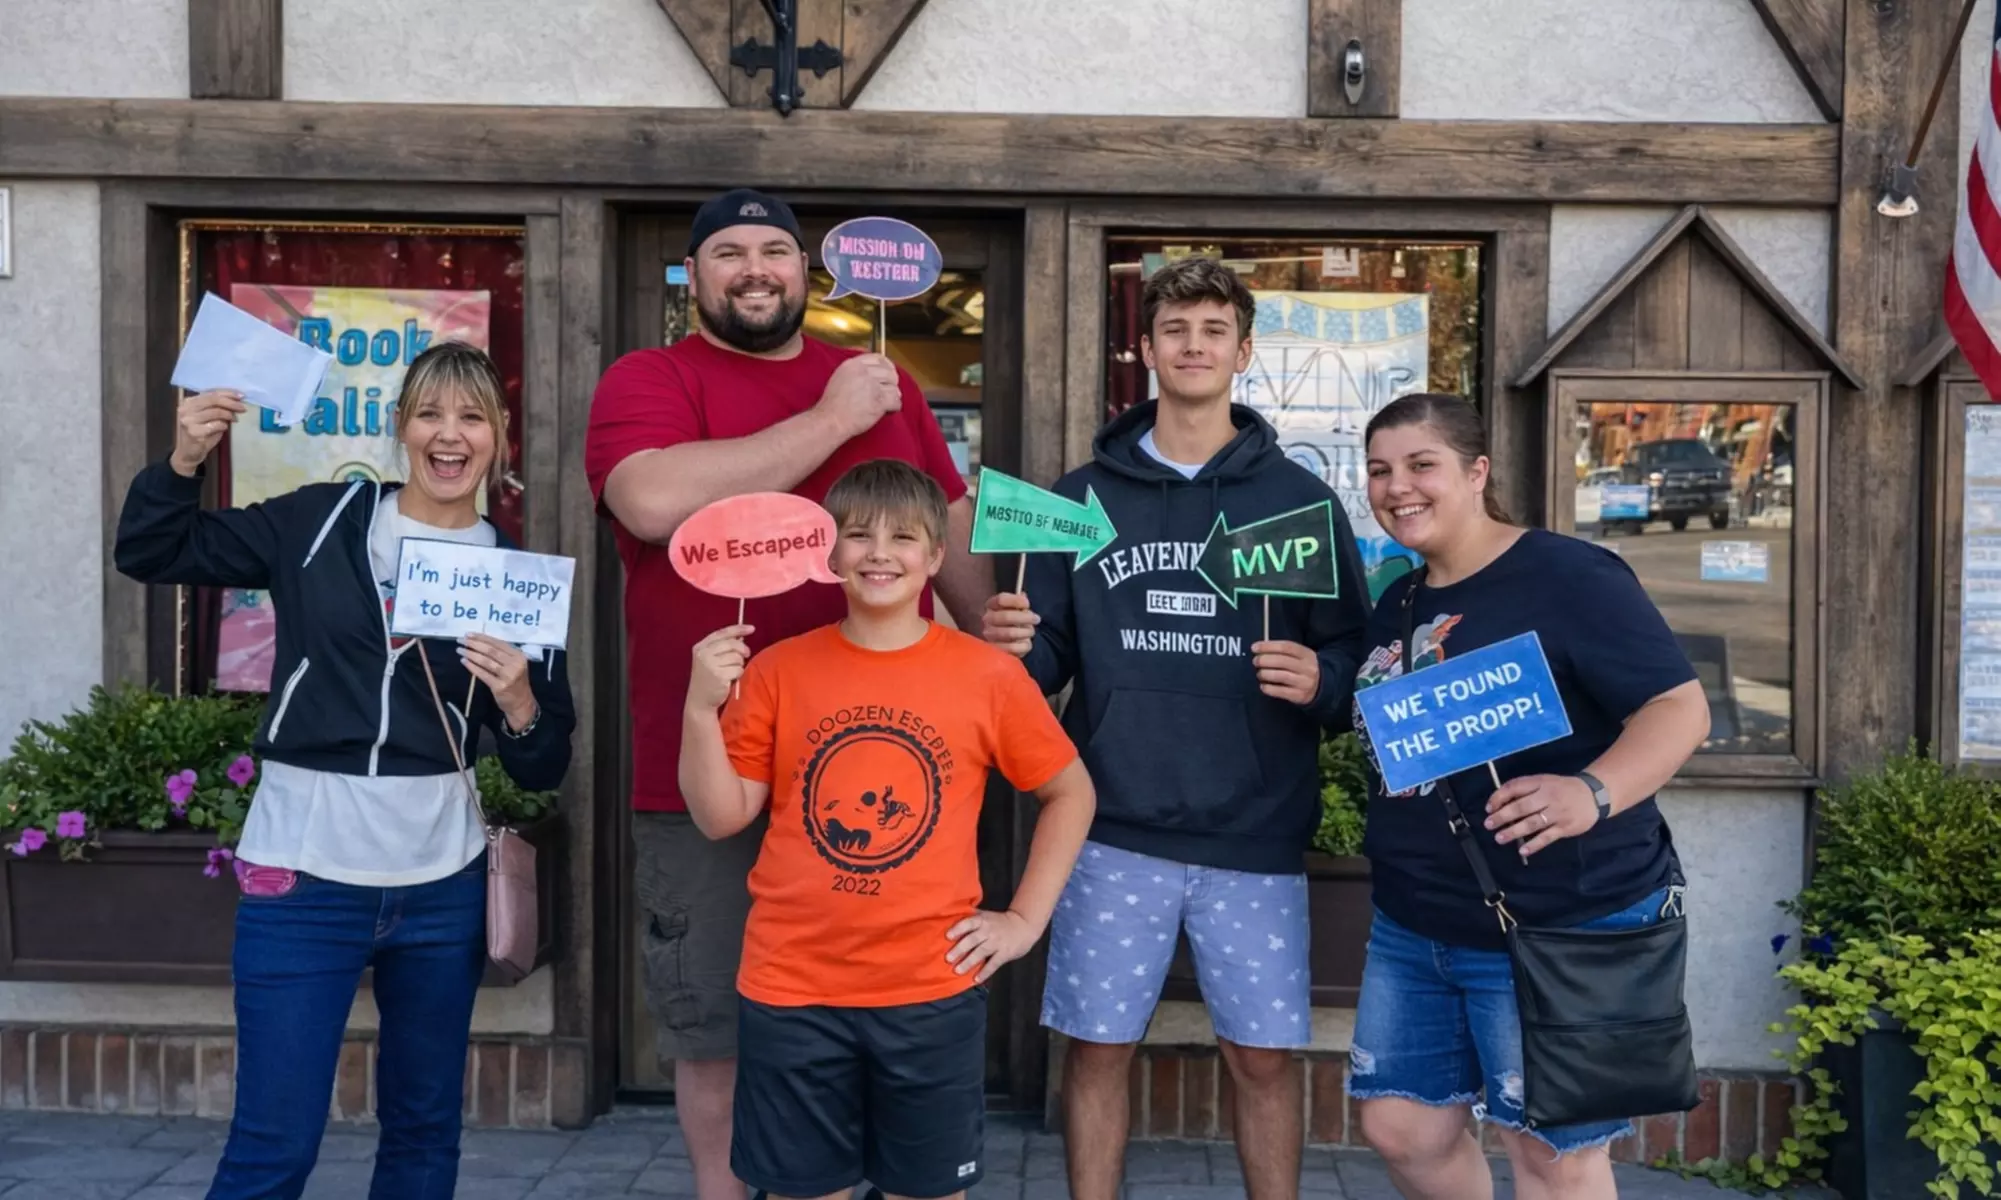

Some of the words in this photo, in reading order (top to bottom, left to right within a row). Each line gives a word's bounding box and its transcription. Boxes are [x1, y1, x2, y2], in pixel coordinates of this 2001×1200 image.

[300, 316, 433, 367] Book
[680, 542, 719, 565] We
[726, 527, 827, 560] Escaped!
[1231, 535, 1320, 579] MVP
[408, 561, 439, 584] I'm
[449, 567, 492, 590] just
[503, 571, 561, 602] happy
[420, 599, 442, 616] to
[453, 600, 478, 620] be
[488, 603, 541, 626] here!
[1383, 692, 1428, 724] WE
[1433, 661, 1522, 708] FOUND
[806, 705, 894, 745] DOOZEN
[1385, 728, 1440, 762] THE
[1445, 692, 1545, 744] PROPP!
[831, 874, 882, 896] 2022
